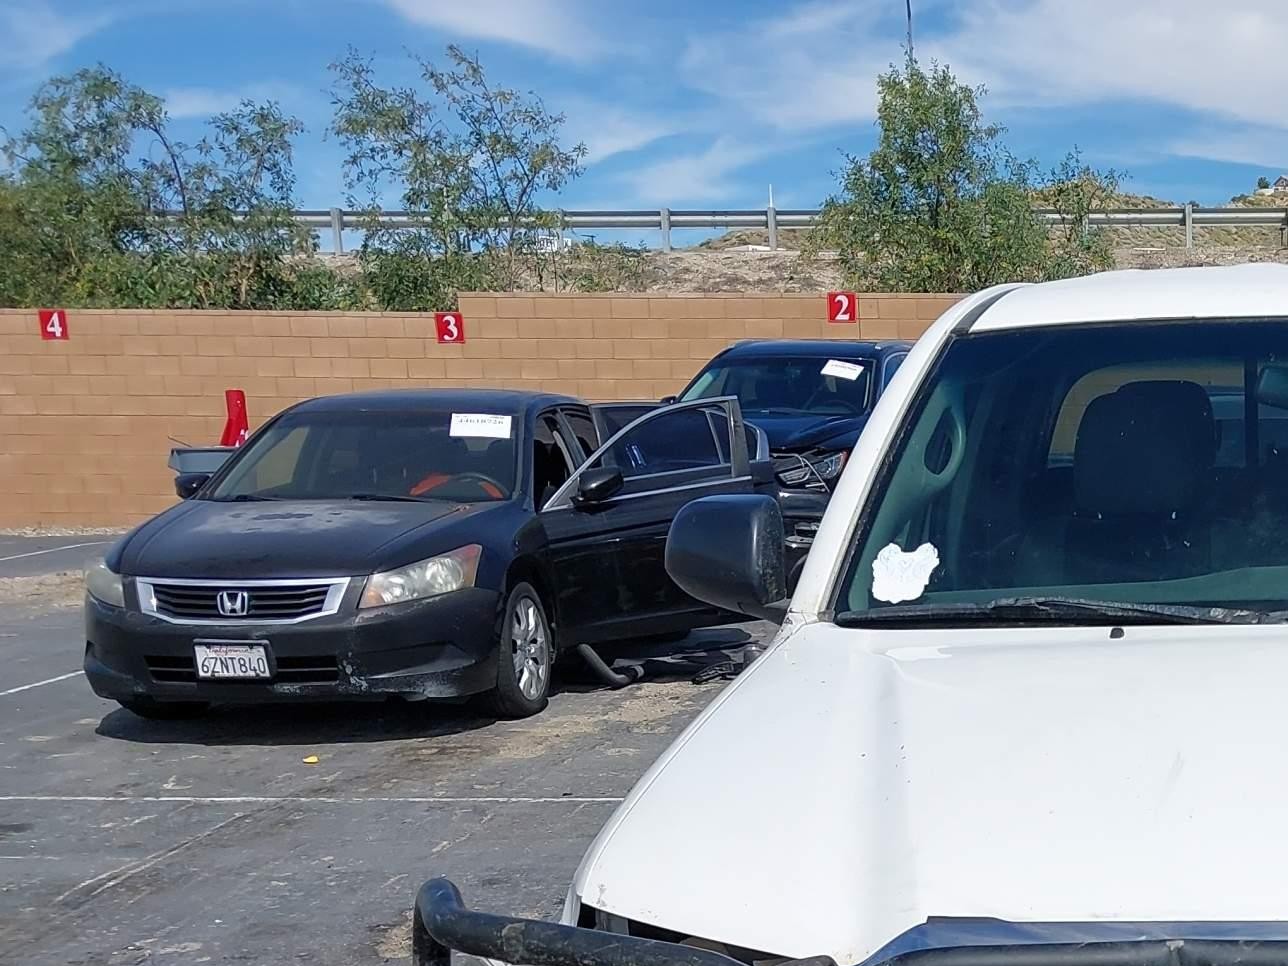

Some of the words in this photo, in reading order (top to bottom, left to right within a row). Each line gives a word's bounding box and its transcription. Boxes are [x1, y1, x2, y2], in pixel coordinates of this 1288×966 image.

[834, 294, 850, 320] 2
[46, 311, 63, 337] 4
[443, 315, 458, 341] 3
[201, 656, 267, 674] 6ZNT840
